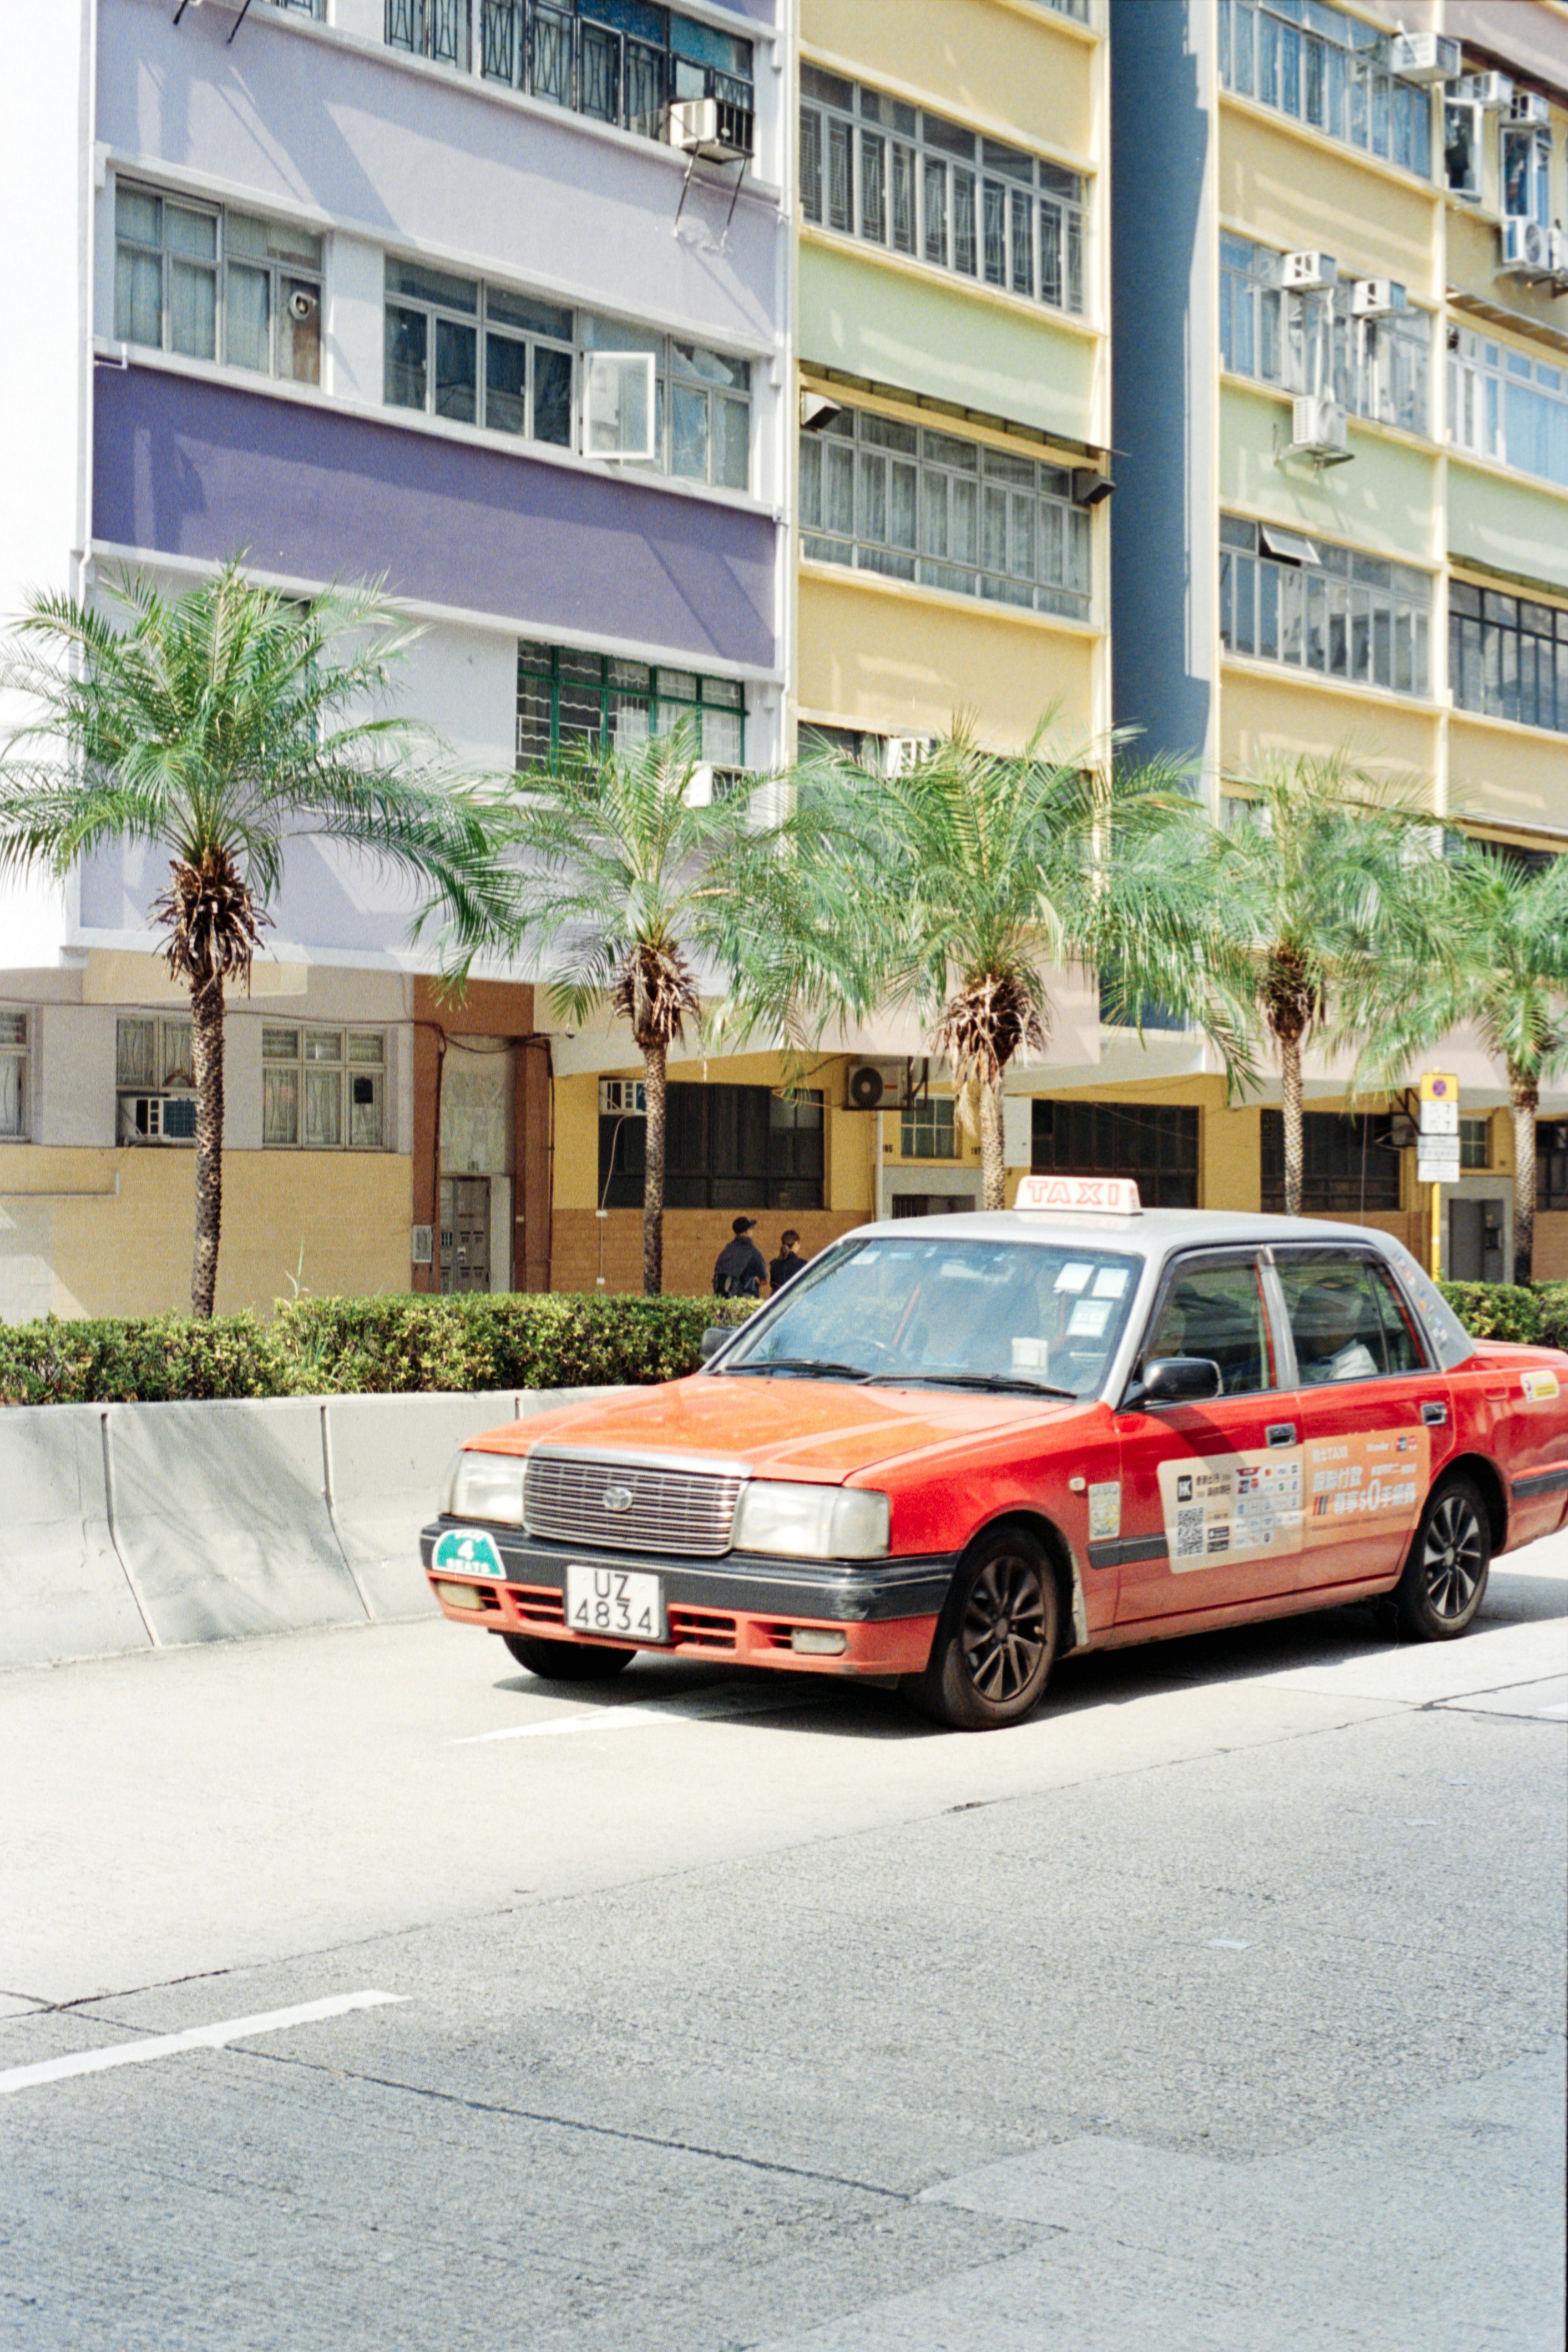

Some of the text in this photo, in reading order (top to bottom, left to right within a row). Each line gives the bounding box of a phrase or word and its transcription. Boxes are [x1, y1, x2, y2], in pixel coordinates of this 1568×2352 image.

[1027, 1180, 1119, 1205] TAXI
[457, 1540, 474, 1560] 4
[446, 1558, 490, 1574] SEATS
[594, 1570, 631, 1602] UZ
[574, 1598, 652, 1634] 4834
